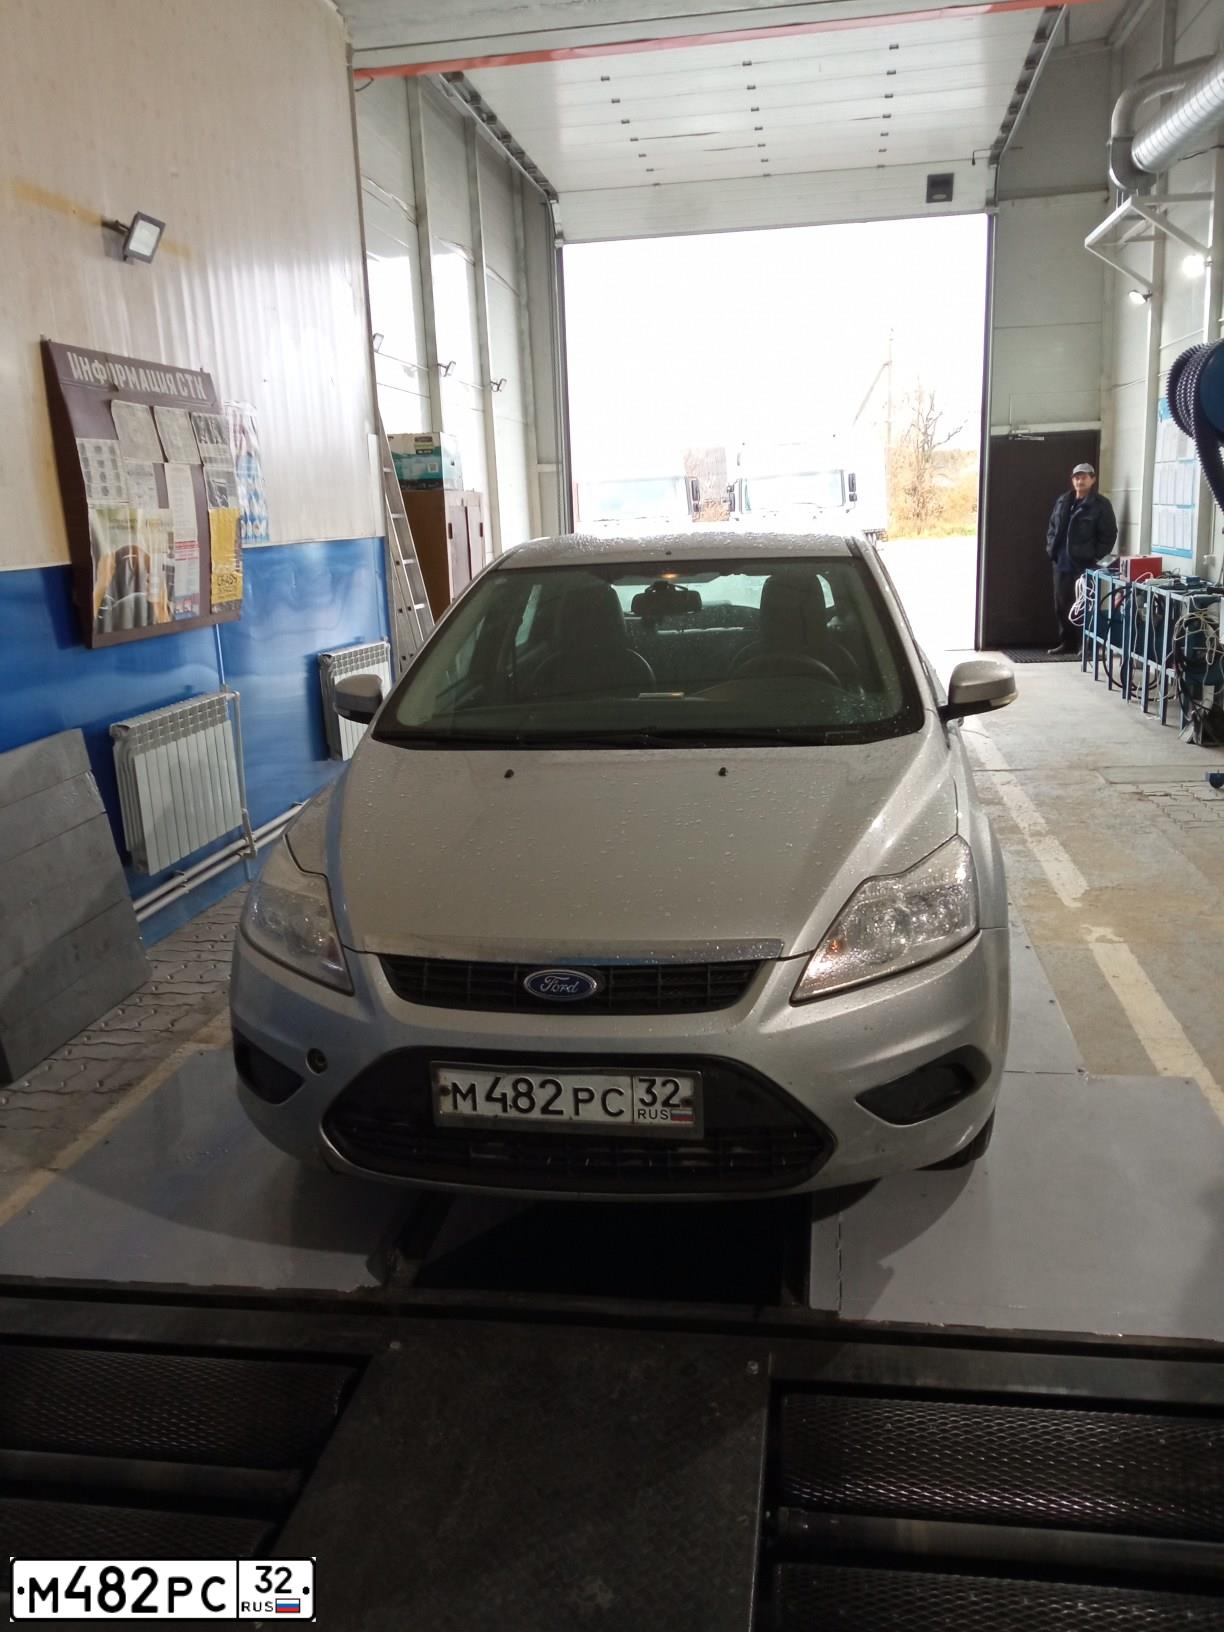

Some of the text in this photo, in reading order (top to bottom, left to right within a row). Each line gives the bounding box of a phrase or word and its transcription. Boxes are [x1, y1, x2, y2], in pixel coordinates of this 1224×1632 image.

[67, 351, 177, 395] ИНФОРМАЦИЯ
[540, 975, 580, 992] Ford
[638, 1078, 681, 1107] 32
[638, 1109, 669, 1120] RUS
